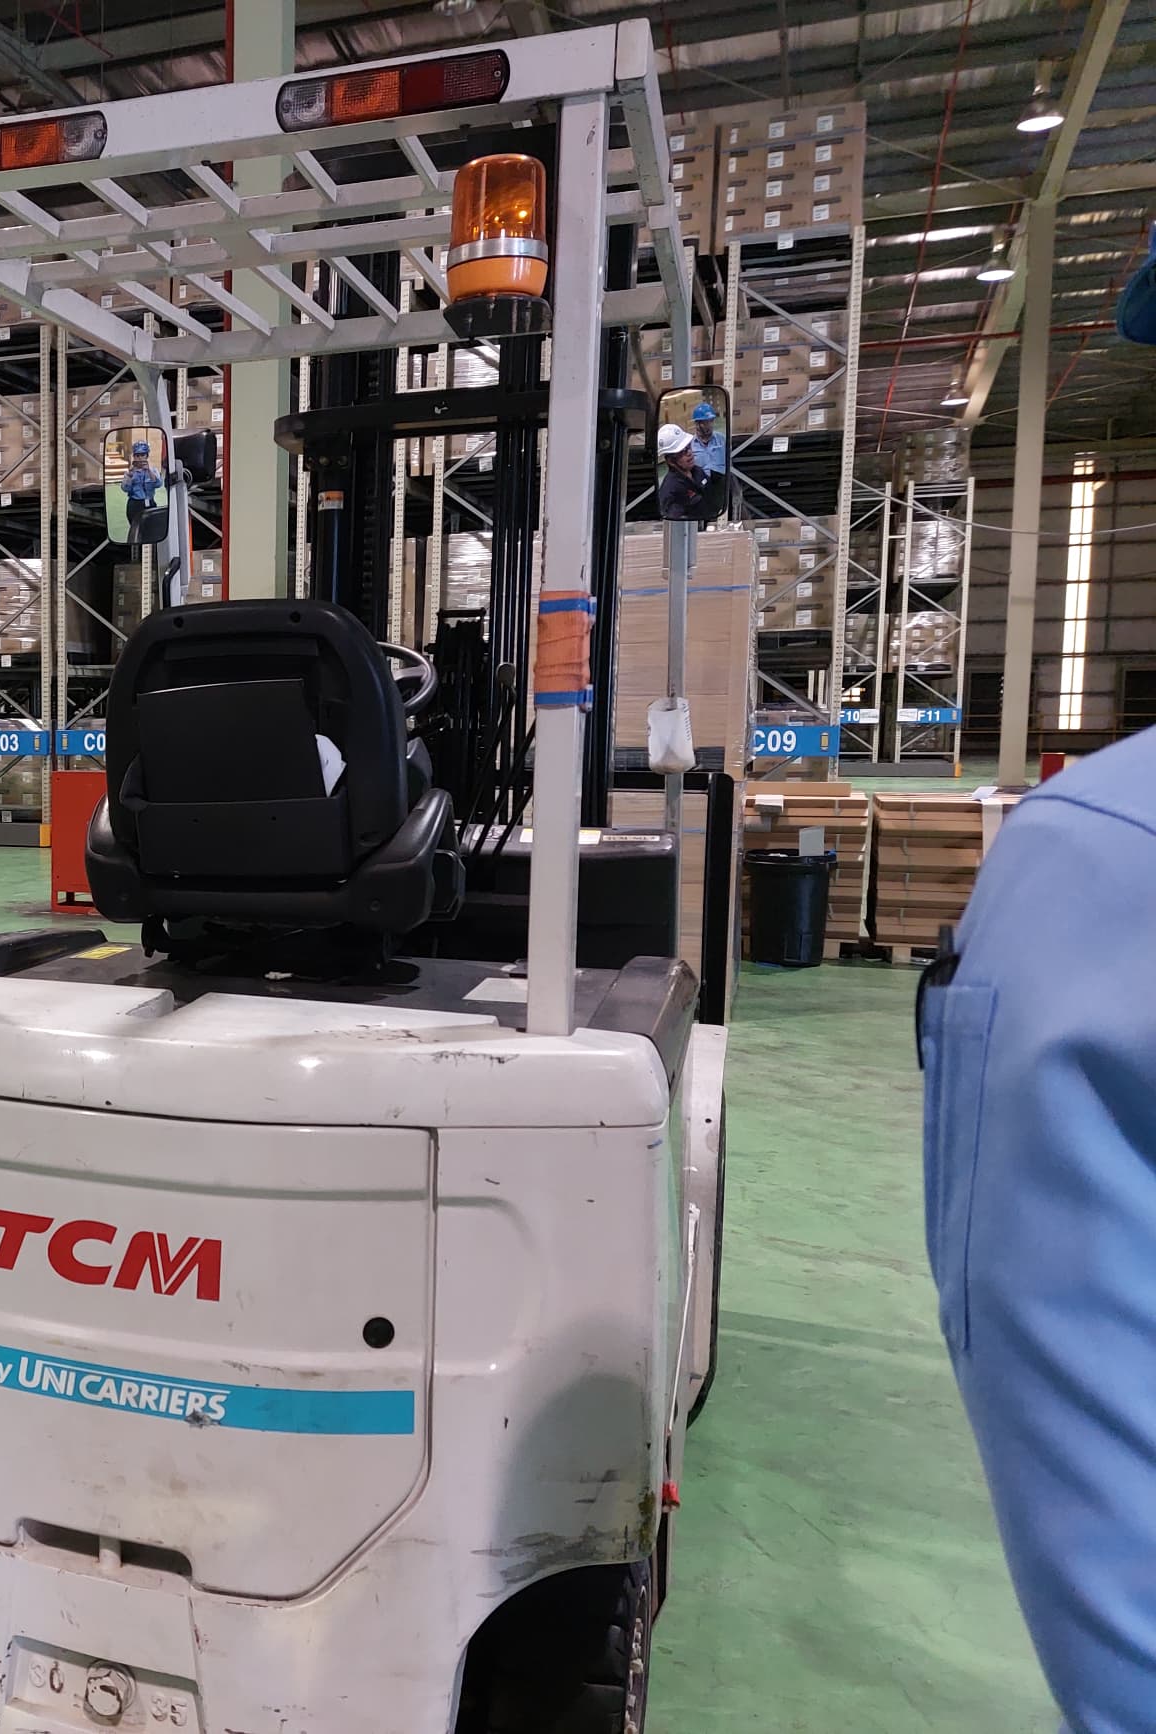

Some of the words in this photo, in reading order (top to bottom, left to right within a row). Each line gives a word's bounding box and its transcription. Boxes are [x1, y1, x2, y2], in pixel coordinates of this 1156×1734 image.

[839, 710, 860, 722] F10
[917, 710, 940, 722] F11
[83, 733, 106, 751] C0
[753, 729, 797, 753] C09
